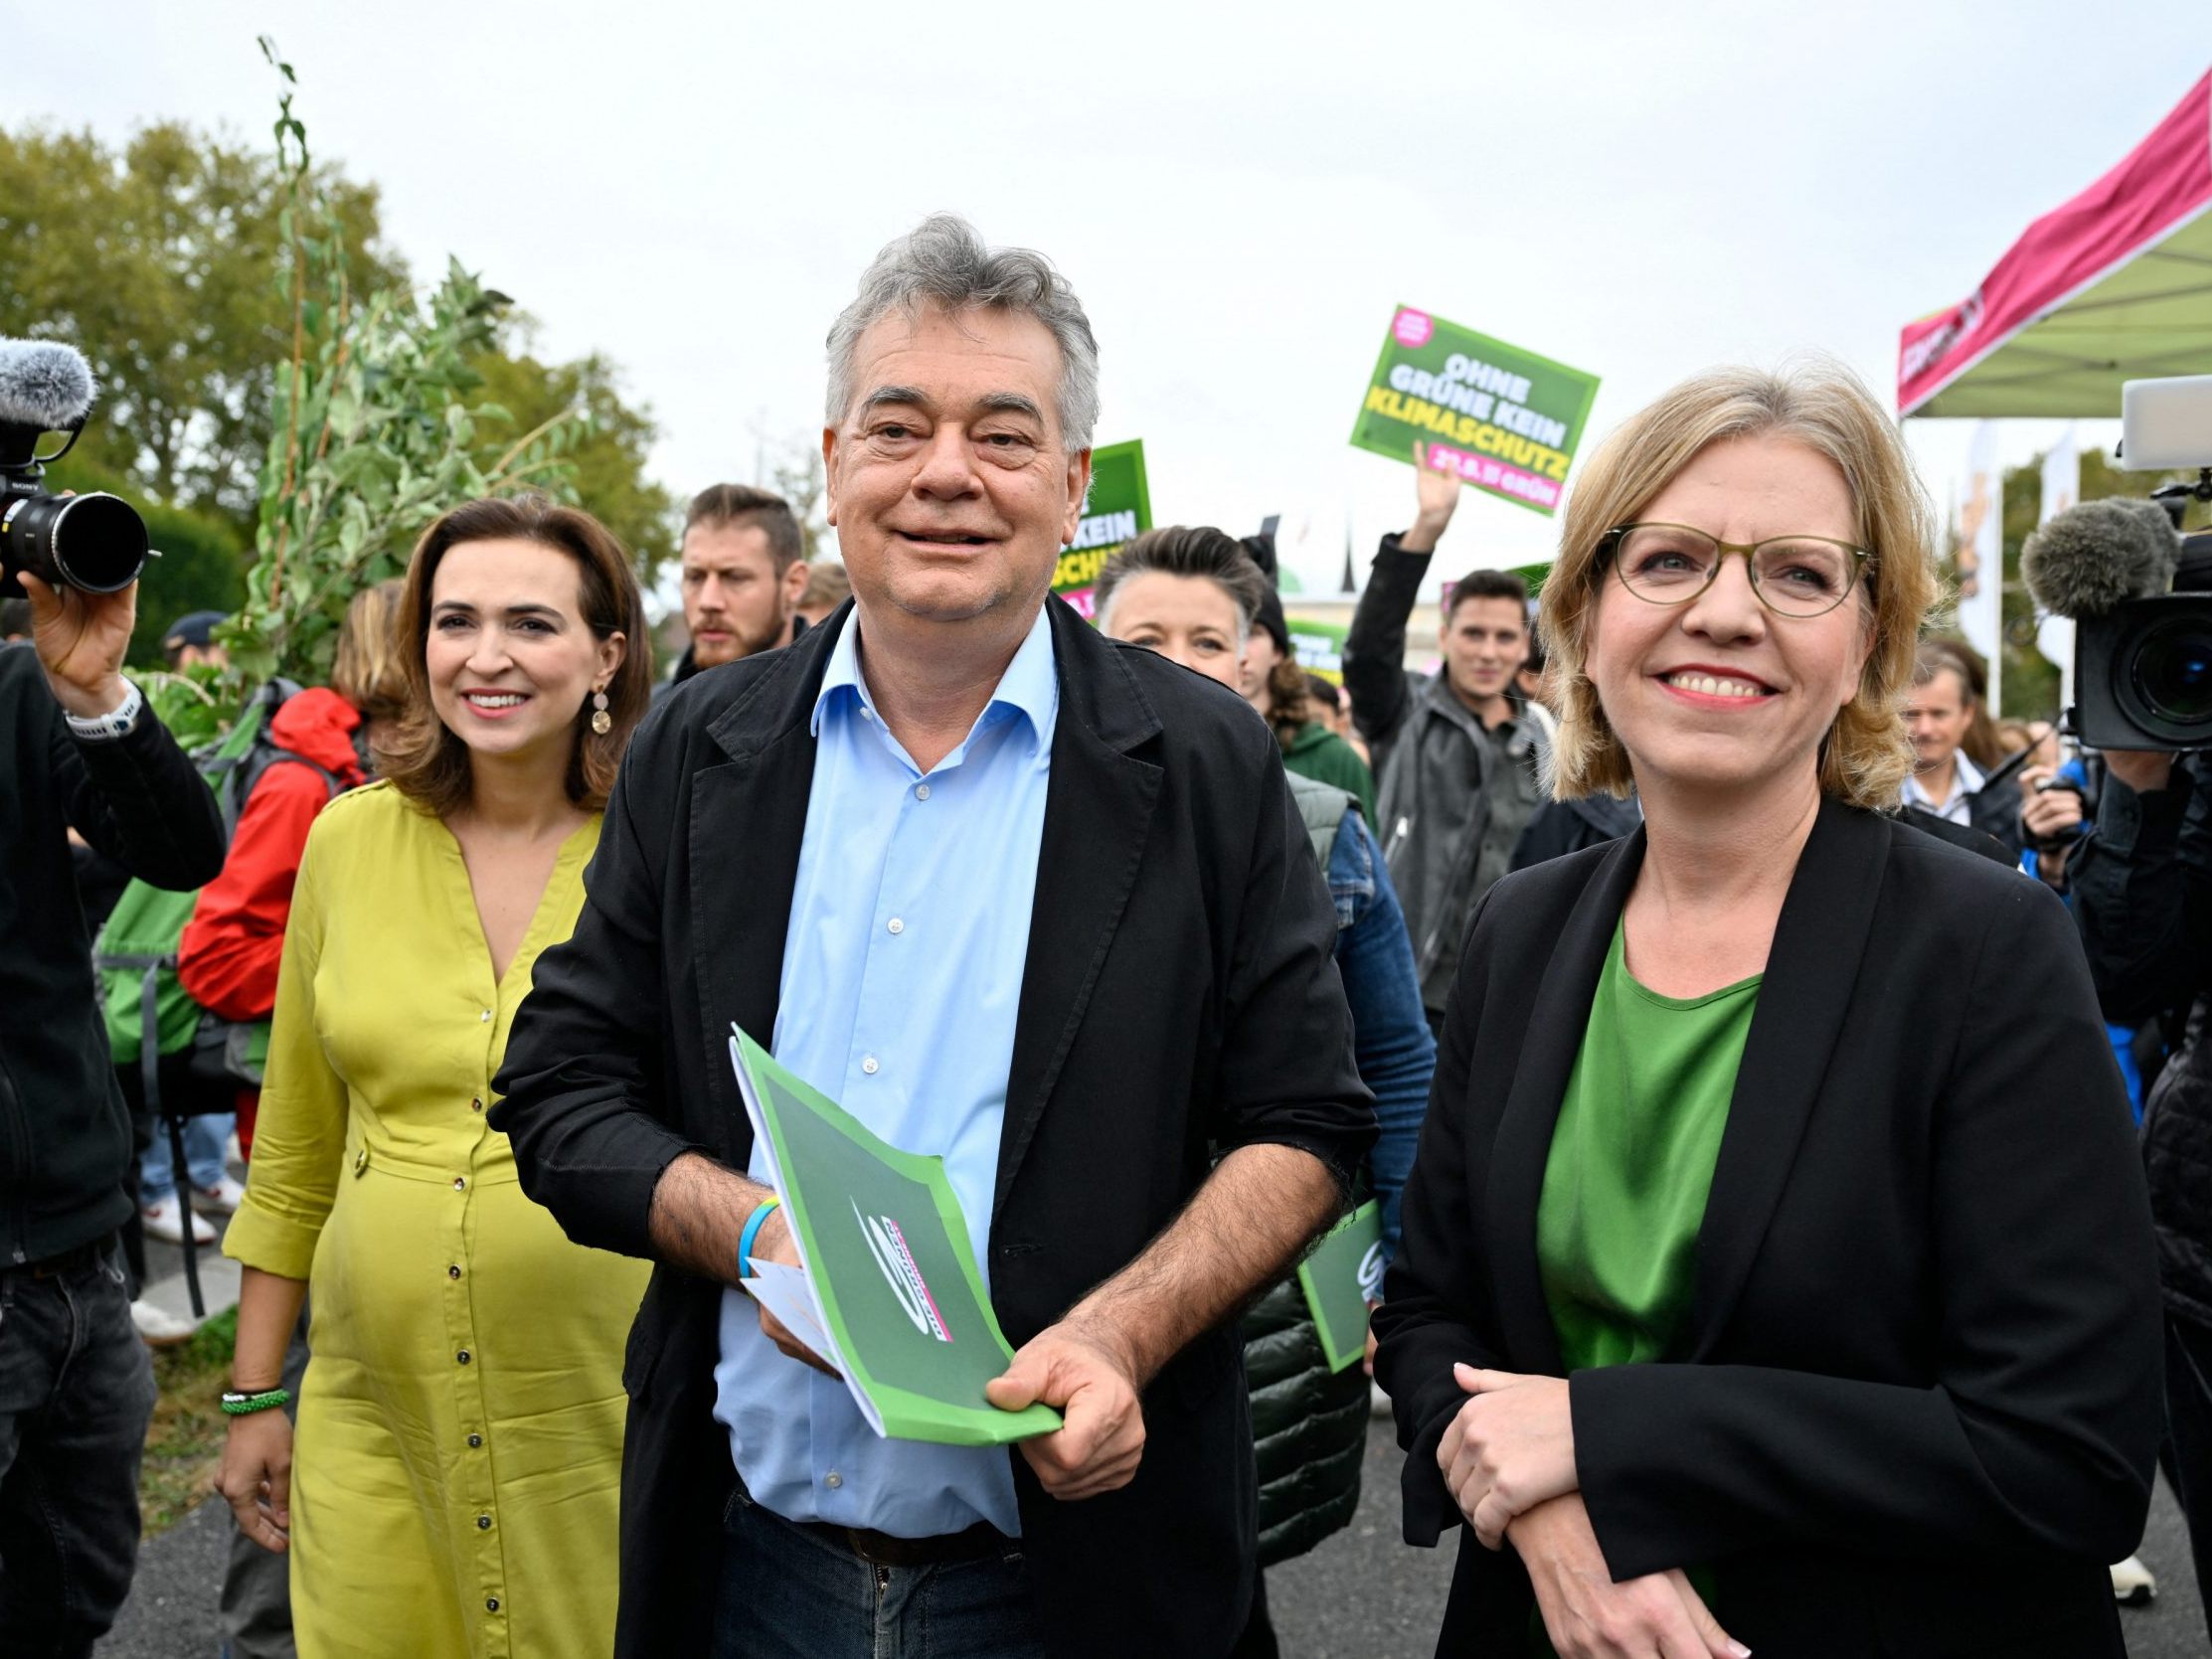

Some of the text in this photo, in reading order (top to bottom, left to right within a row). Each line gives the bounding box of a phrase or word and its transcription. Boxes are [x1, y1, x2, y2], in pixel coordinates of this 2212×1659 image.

[1389, 364, 1566, 448] GRÜNE KEIN
[1445, 353, 1532, 404] OHNE
[1365, 385, 1571, 481] KLIMASCHUTZ
[1072, 509, 1137, 550] KEIN
[886, 1222, 942, 1336] DIE GRÜNEN
